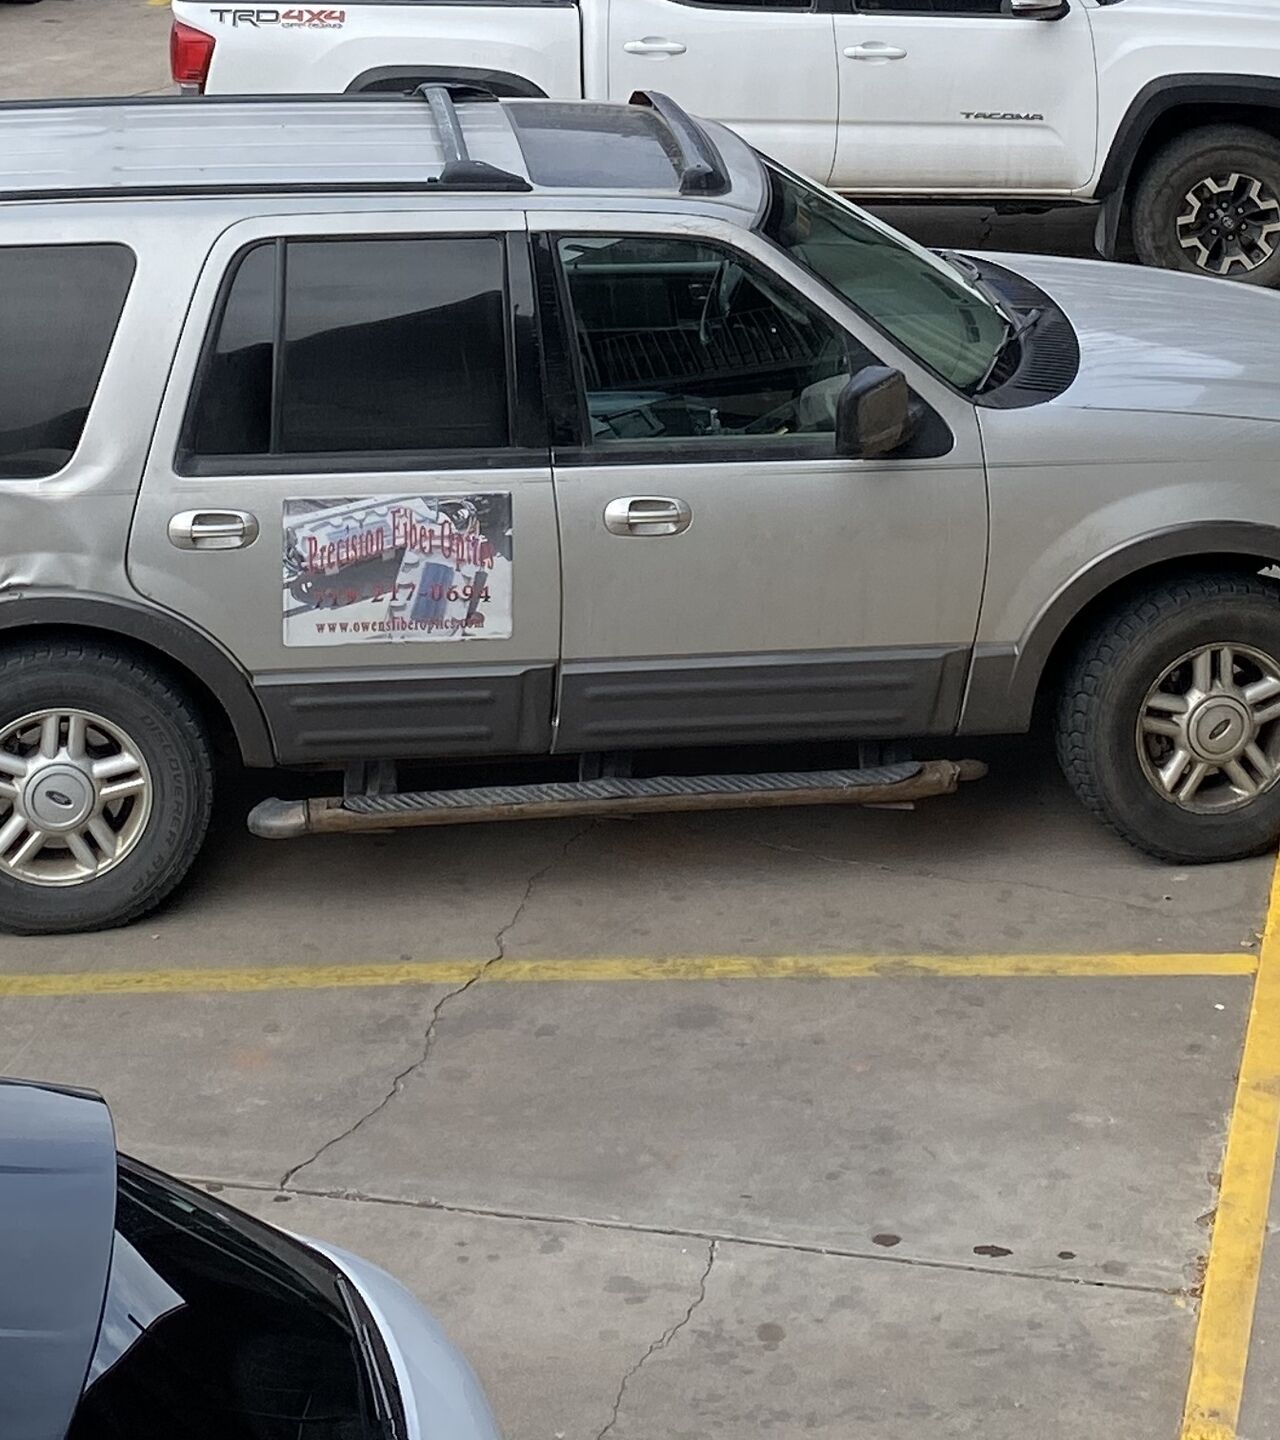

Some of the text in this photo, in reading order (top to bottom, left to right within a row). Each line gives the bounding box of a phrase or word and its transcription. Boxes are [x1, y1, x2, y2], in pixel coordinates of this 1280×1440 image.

[960, 112, 1044, 121] TACOMA
[305, 506, 494, 573] Precision Fiber Optics
